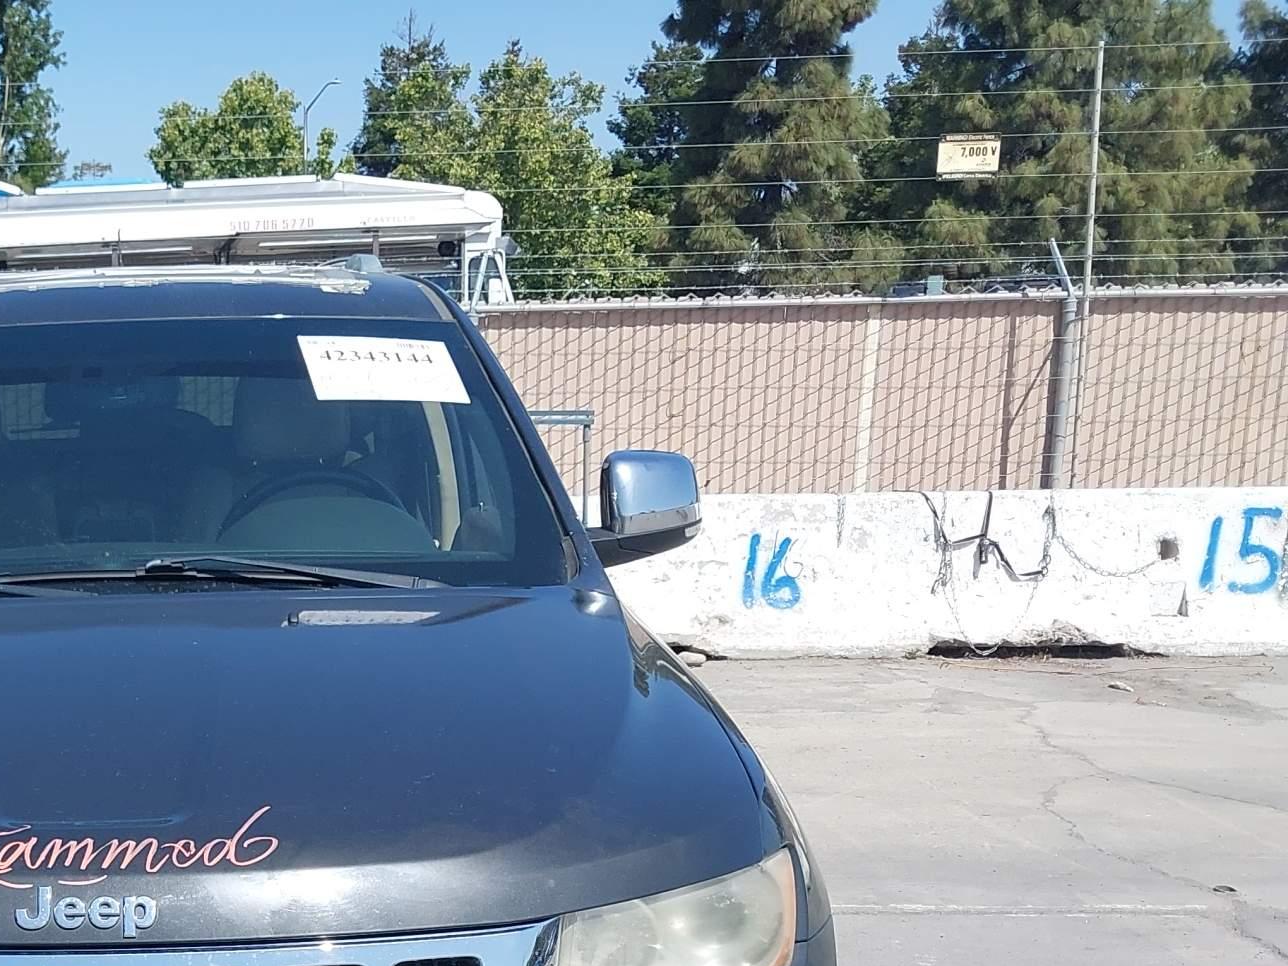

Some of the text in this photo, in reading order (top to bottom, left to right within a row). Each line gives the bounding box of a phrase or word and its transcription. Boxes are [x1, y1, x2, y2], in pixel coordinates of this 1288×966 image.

[960, 146, 997, 158] 7,000 V
[319, 350, 434, 365] 42343144
[742, 533, 801, 609] 16
[1199, 507, 1283, 594] 15
[15, 886, 158, 939] Jeep
